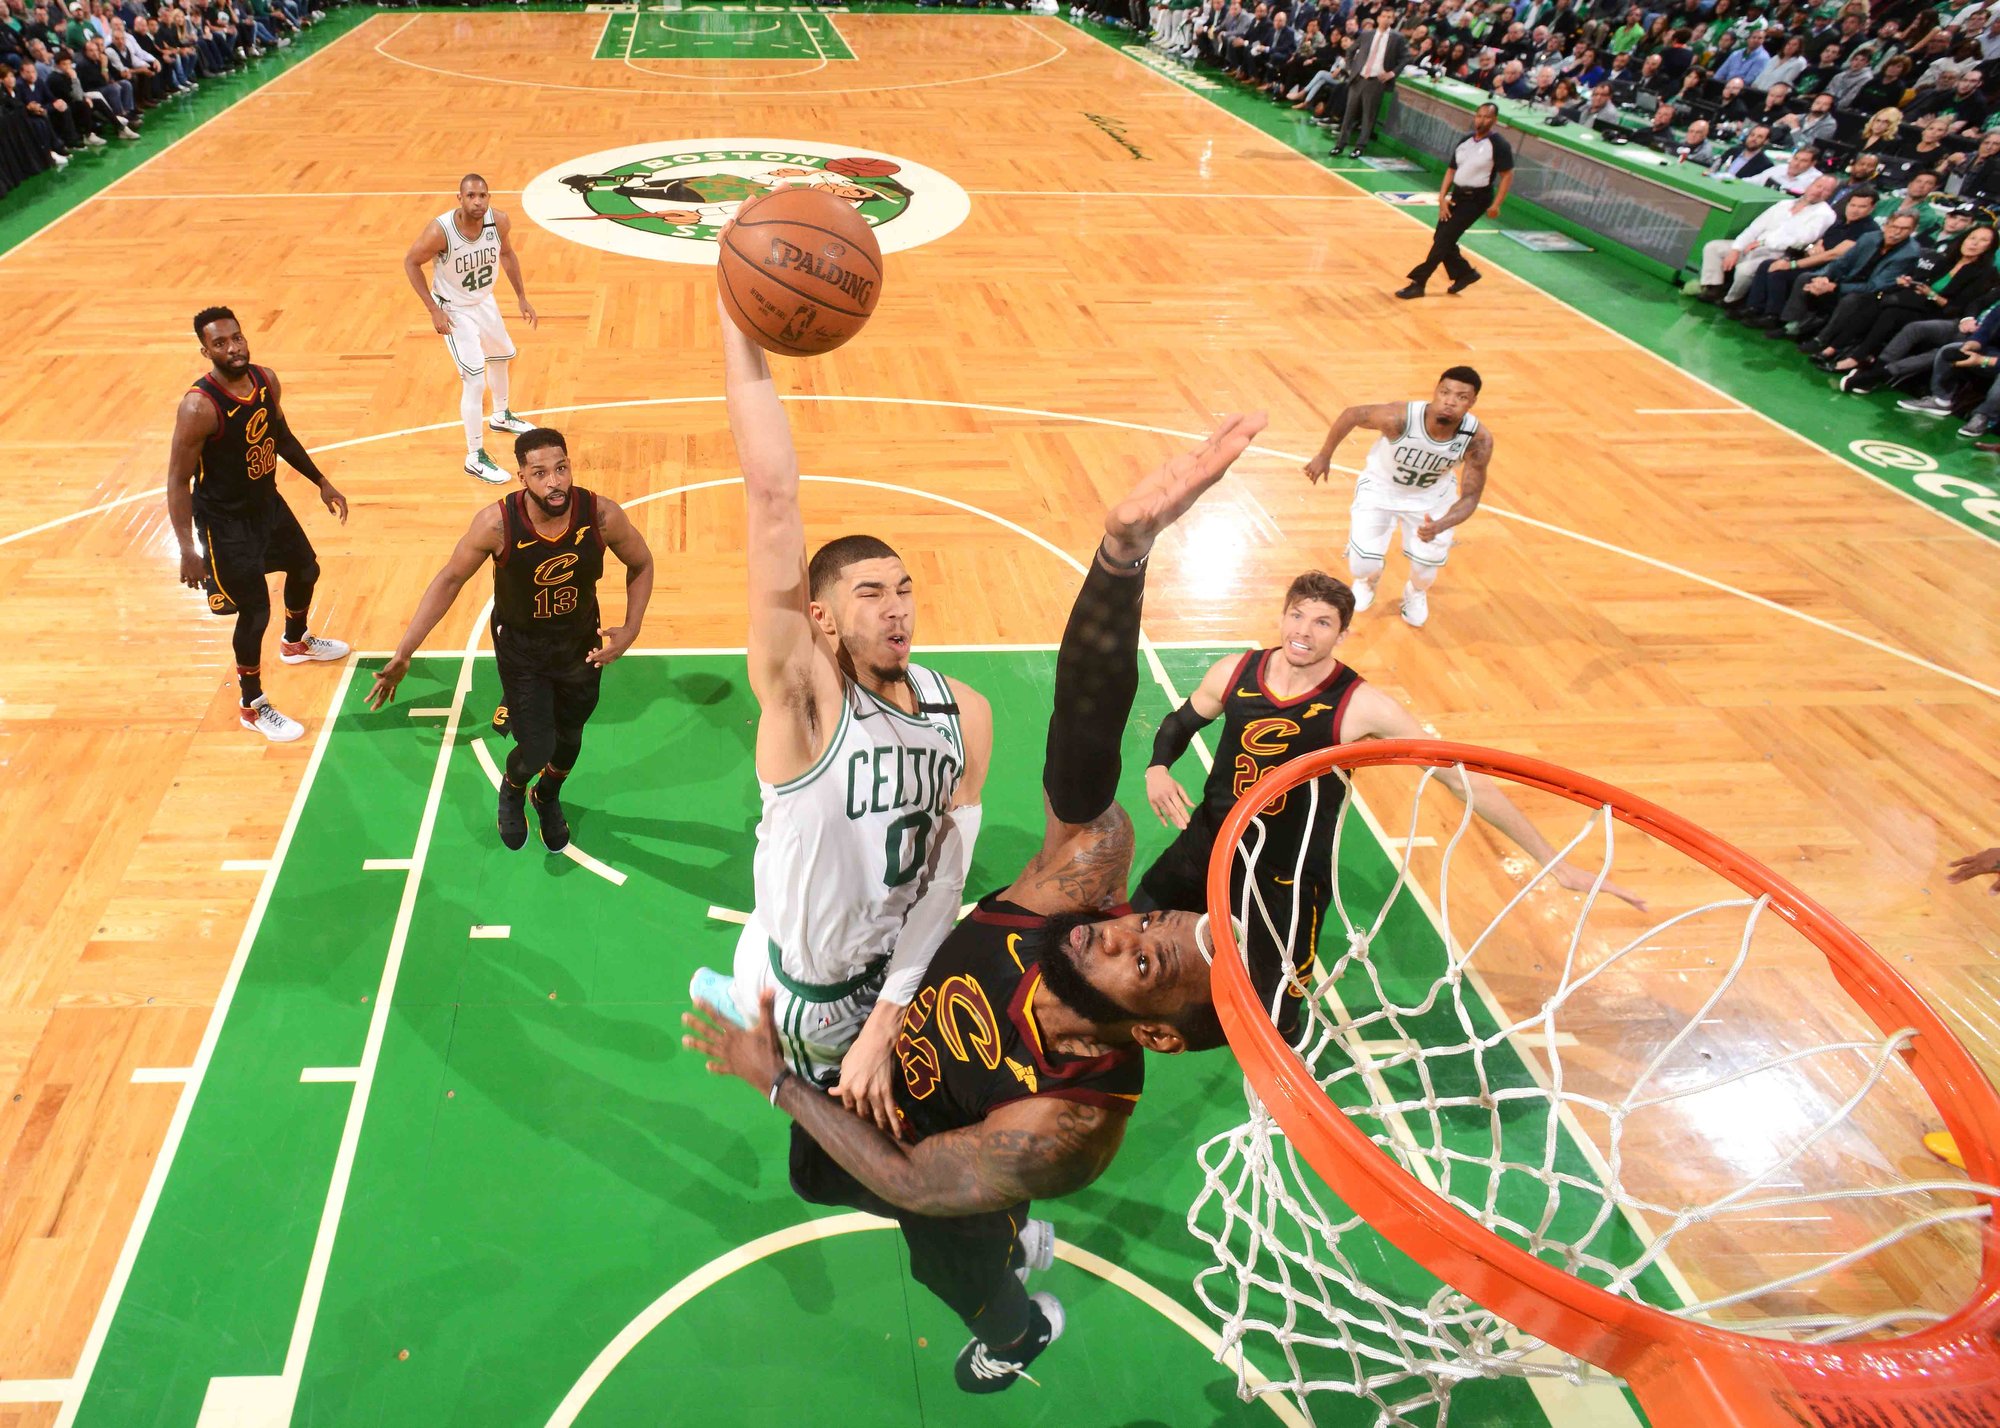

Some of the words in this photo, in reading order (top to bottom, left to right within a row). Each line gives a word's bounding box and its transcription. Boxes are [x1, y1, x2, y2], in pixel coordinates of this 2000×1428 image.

[640, 151, 821, 170] BOSTON
[455, 247, 497, 274] CELTICS
[764, 238, 874, 308] SPALDING
[461, 265, 493, 292] 42
[246, 437, 276, 480] 32
[1392, 466, 1442, 489] 36
[533, 586, 578, 618] 13
[883, 810, 933, 888] 0
